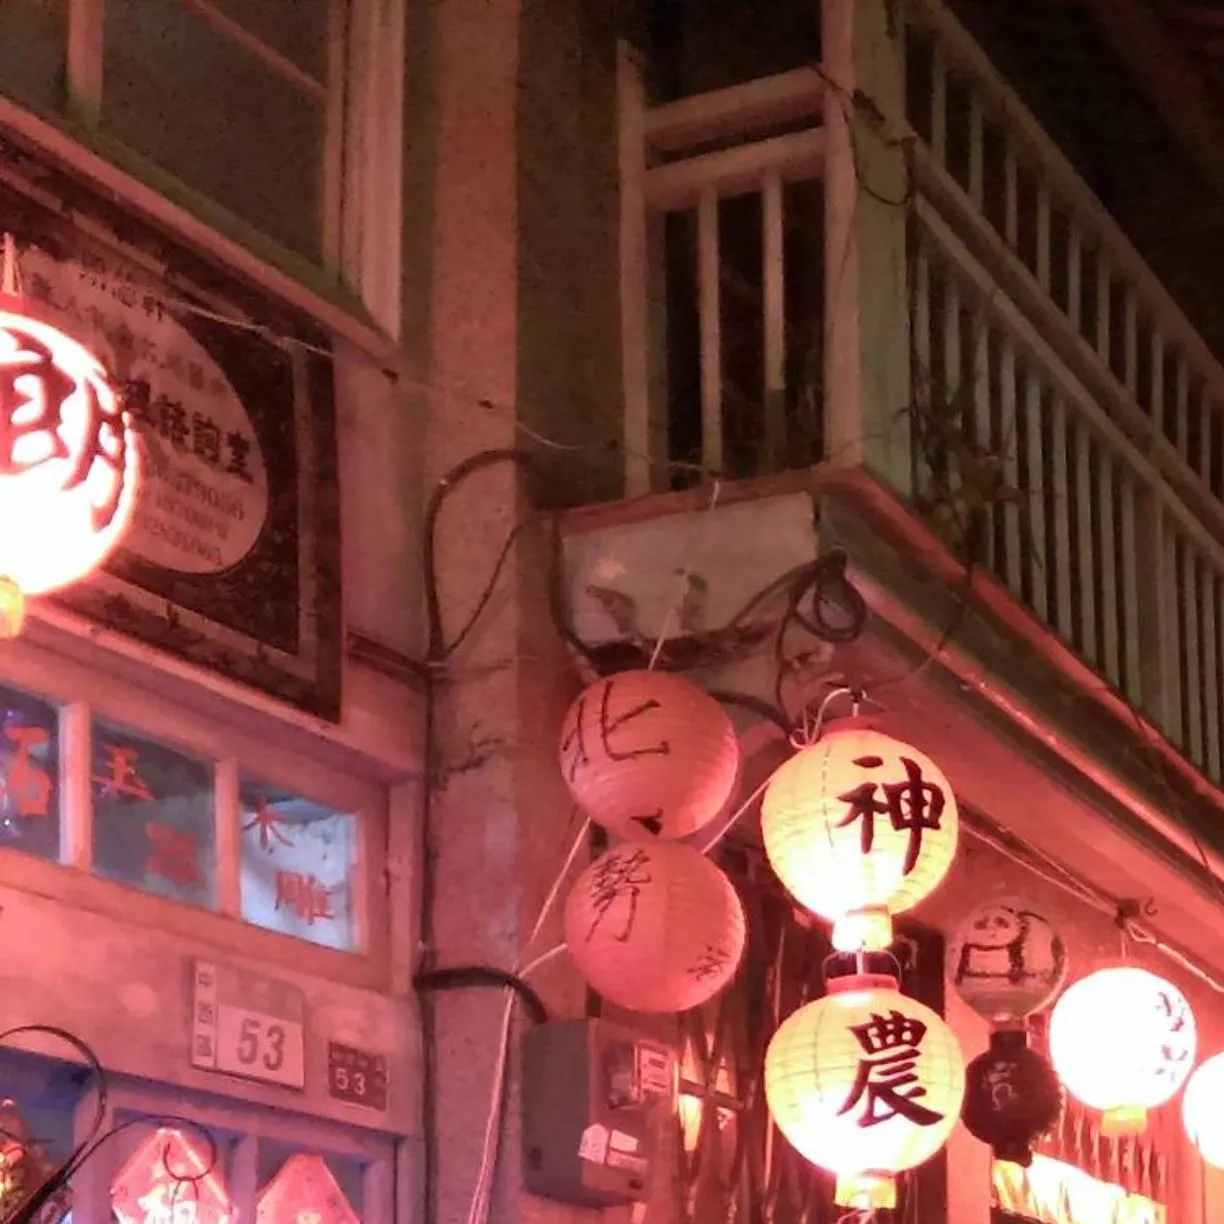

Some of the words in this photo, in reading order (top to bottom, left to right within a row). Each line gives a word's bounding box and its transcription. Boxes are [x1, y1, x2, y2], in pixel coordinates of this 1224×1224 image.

[836, 755, 946, 876] 神
[235, 1018, 286, 1072] 53
[334, 1067, 367, 1096] 53
[836, 1009, 945, 1128] 農
